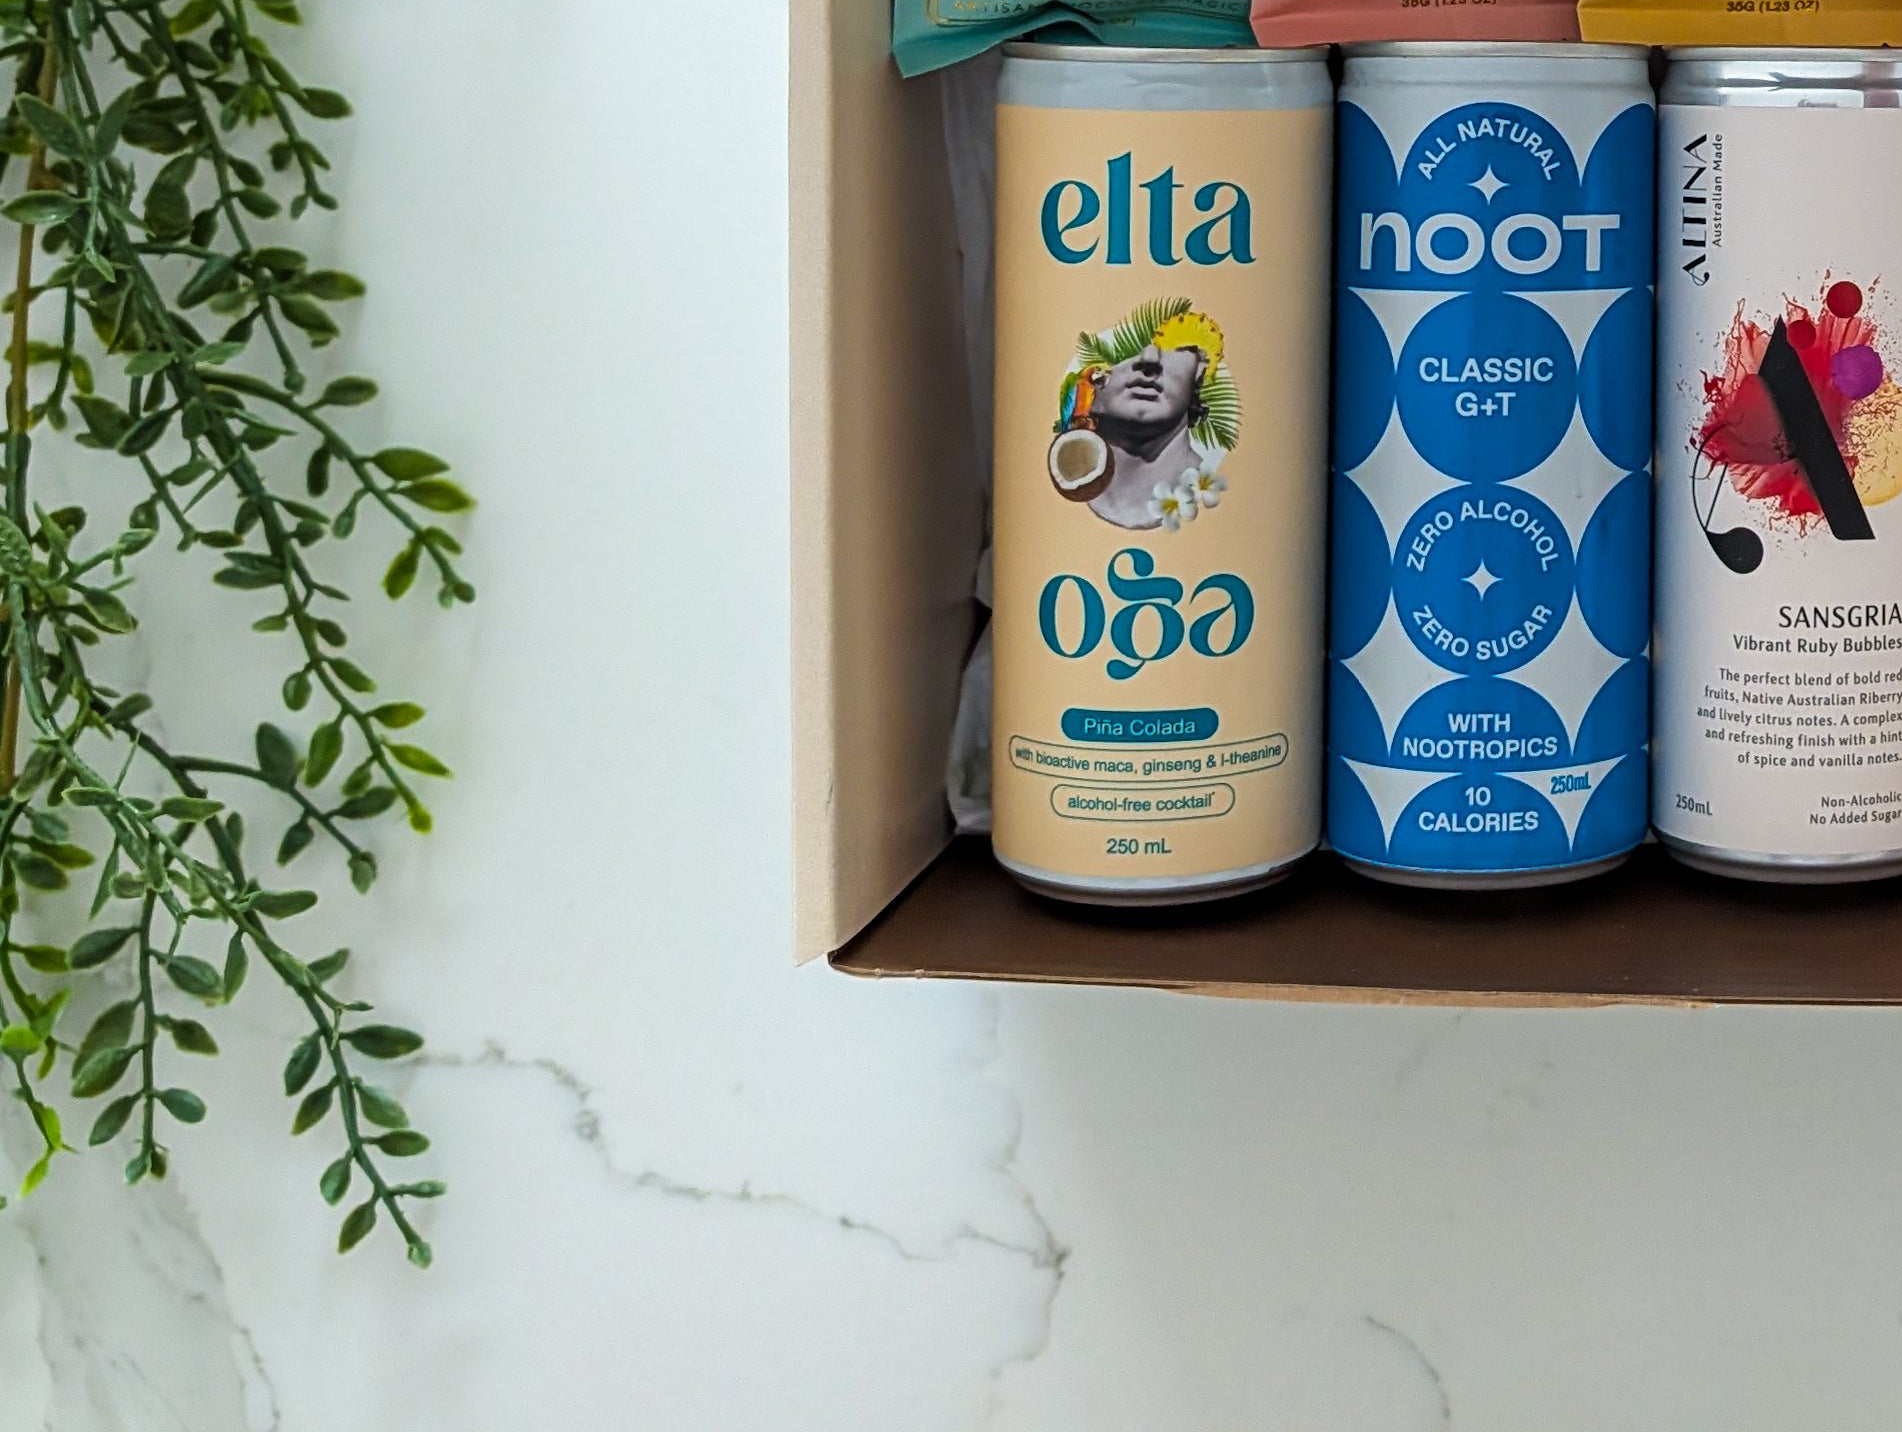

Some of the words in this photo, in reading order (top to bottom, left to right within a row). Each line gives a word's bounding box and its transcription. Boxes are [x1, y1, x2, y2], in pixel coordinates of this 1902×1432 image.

[1417, 136, 1457, 181] ALL
[1457, 117, 1563, 181] NATURAL
[1712, 133, 1723, 172] Made
[1040, 151, 1257, 268] elta
[1682, 133, 1711, 287] ALTINA
[1712, 173, 1723, 248] Australian
[1419, 356, 1554, 383] CLASSIC
[1454, 392, 1517, 417] G+T
[1405, 511, 1454, 572] ZERO
[1459, 499, 1559, 572] ALCOHOL
[1412, 605, 1470, 659] ZERO
[1475, 604, 1553, 660] SUGAR
[1733, 633, 1793, 653] Vibrant
[1797, 637, 1839, 657] Ruby
[1719, 667, 1741, 682] The
[1743, 671, 1791, 687] perfect
[1794, 672, 1832, 686] blend
[1836, 671, 1850, 686] of
[1853, 670, 1881, 685] bold
[1704, 685, 1740, 704] fruits,
[1742, 690, 1783, 706] Native
[1787, 692, 1856, 707] Australian
[1084, 717, 1123, 736] Piña
[1129, 717, 1196, 736] Colada
[1448, 712, 1511, 733] WITH
[1696, 706, 1716, 720] and
[1719, 707, 1752, 726] lively
[1755, 712, 1793, 727] citrus
[1796, 714, 1838, 727] notes.
[1840, 713, 1850, 726] A
[1853, 709, 1902, 729] complex
[1403, 736, 1559, 759] NOOTROPICS
[1705, 727, 1725, 742] and
[1728, 729, 1794, 750] refreshing
[1797, 733, 1836, 748] finish
[1839, 731, 1867, 746] with
[1870, 734, 1877, 745] a
[1880, 729, 1902, 744] hint
[1015, 746, 1034, 763] with
[1036, 750, 1091, 771] bioactive
[1094, 759, 1139, 775] maca,
[1142, 757, 1202, 775] ginseng
[1206, 754, 1216, 768] &
[1737, 751, 1750, 765] of
[1754, 752, 1787, 768] spice
[1790, 753, 1815, 768] and
[1818, 752, 1863, 767] vanilla
[1867, 751, 1902, 765] notes.
[1067, 795, 1152, 812] alcohol-free
[1464, 786, 1492, 807] 10
[1674, 793, 1713, 817] 250mL
[1820, 790, 1902, 808] Non-Alcoholic
[1418, 811, 1540, 833] CALORIES
[1809, 813, 1827, 825] No
[1830, 811, 1869, 825] Added
[1871, 807, 1902, 824] Sugar
[1106, 837, 1139, 855] 250
[1144, 838, 1172, 854] mL
